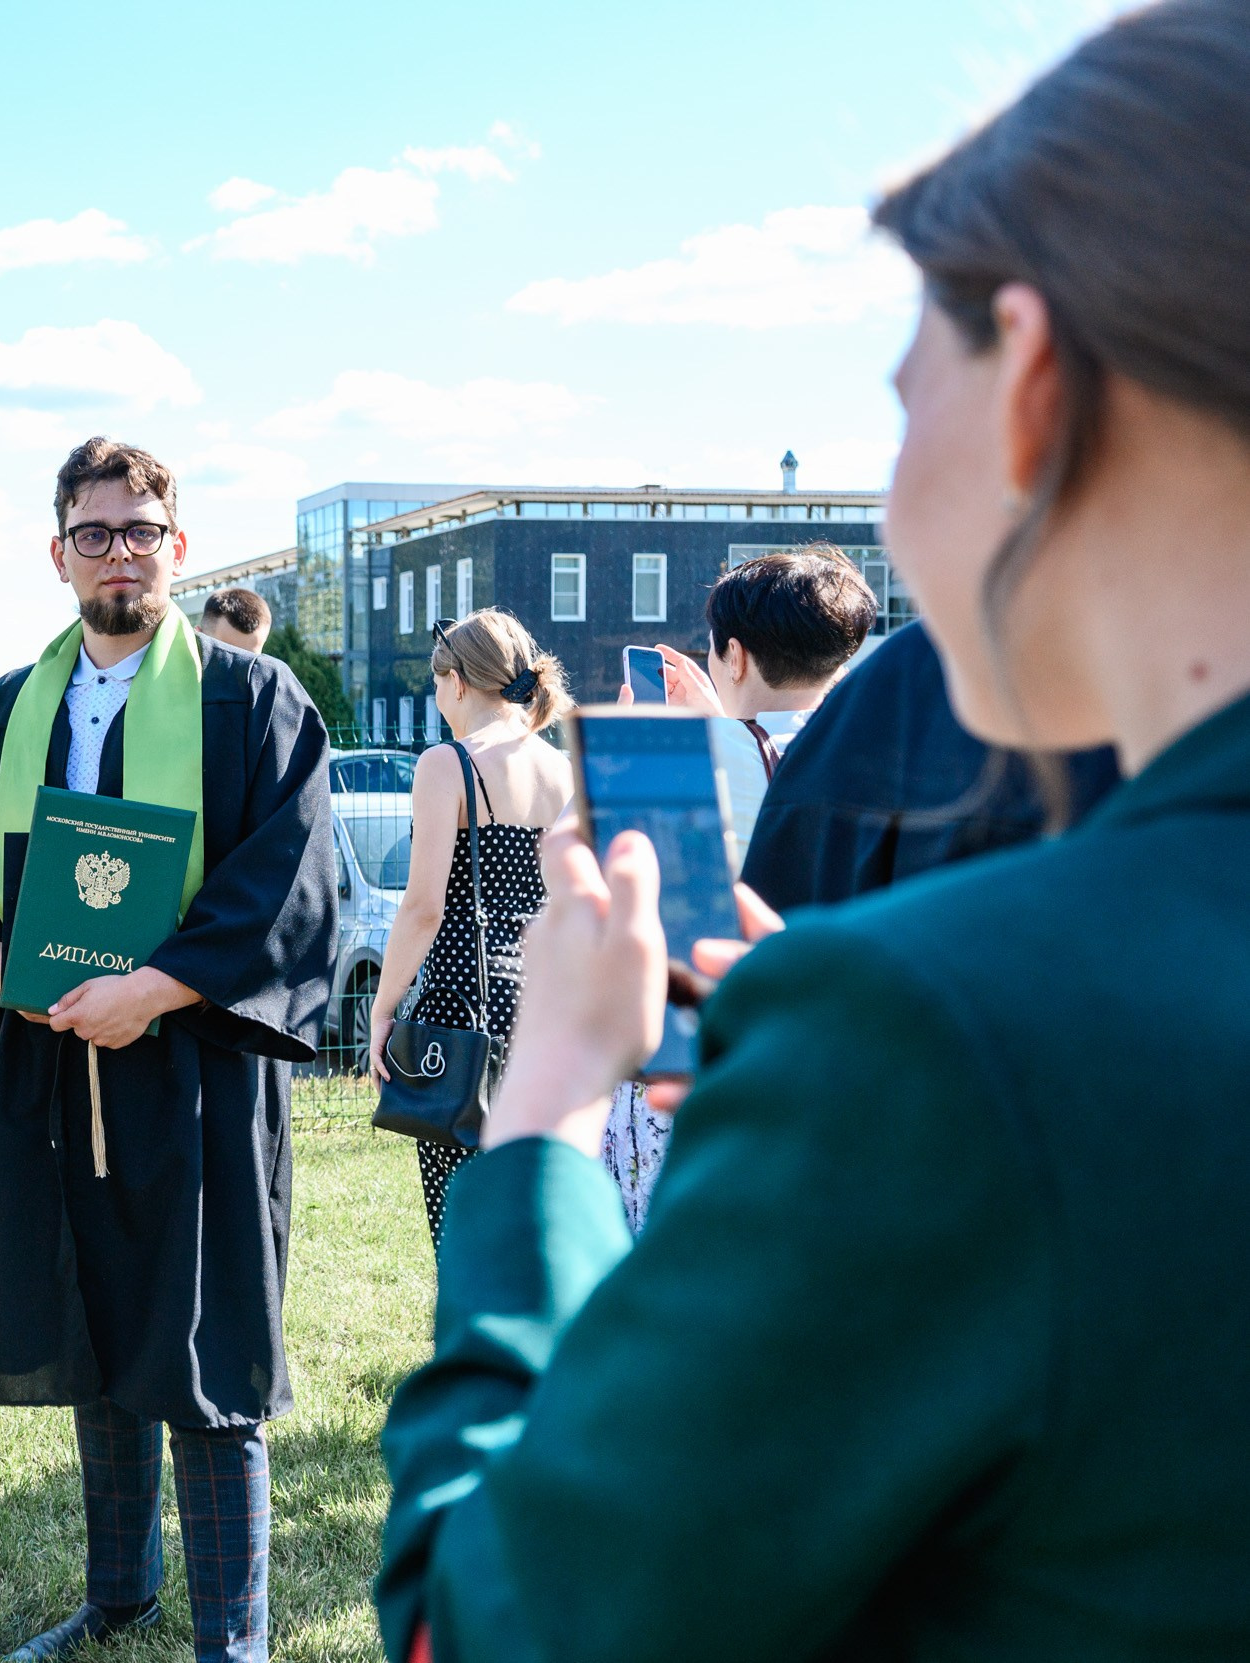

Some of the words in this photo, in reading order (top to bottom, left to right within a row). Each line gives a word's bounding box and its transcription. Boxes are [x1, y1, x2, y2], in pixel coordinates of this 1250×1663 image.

[46, 815, 84, 827] МОСКОВСКИЙ
[84, 822, 137, 836] ГОСУДАРСТВЕННЫЙ
[138, 831, 176, 843] УНИВЕРСИТЕТ
[75, 826, 97, 835] ИМЕНИ
[39, 942, 134, 973] ДИПЛОМ
